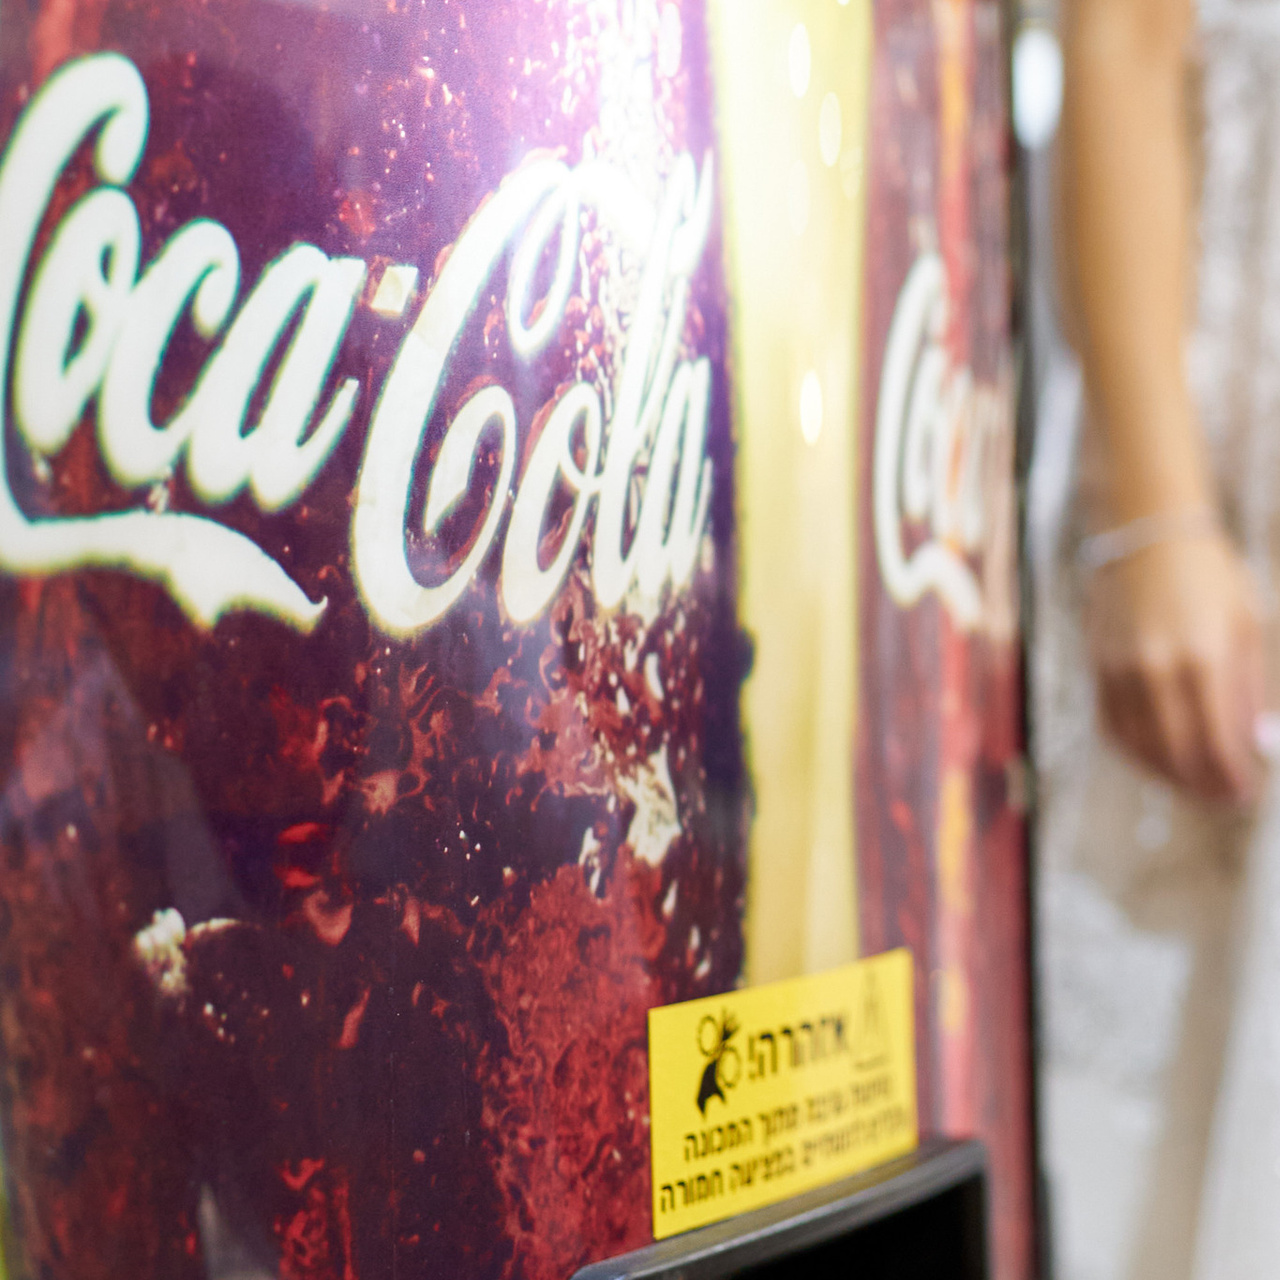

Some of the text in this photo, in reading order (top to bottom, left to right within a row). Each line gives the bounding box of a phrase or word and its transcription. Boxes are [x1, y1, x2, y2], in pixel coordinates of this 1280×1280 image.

[0, 52, 713, 638] Coca-Cola
[748, 1011, 851, 1080] אזהרה!
[684, 1119, 752, 1162] המכונה
[758, 1101, 799, 1145] מתוך
[659, 1167, 725, 1214] חמורה
[728, 1146, 796, 1193] בפציעה
